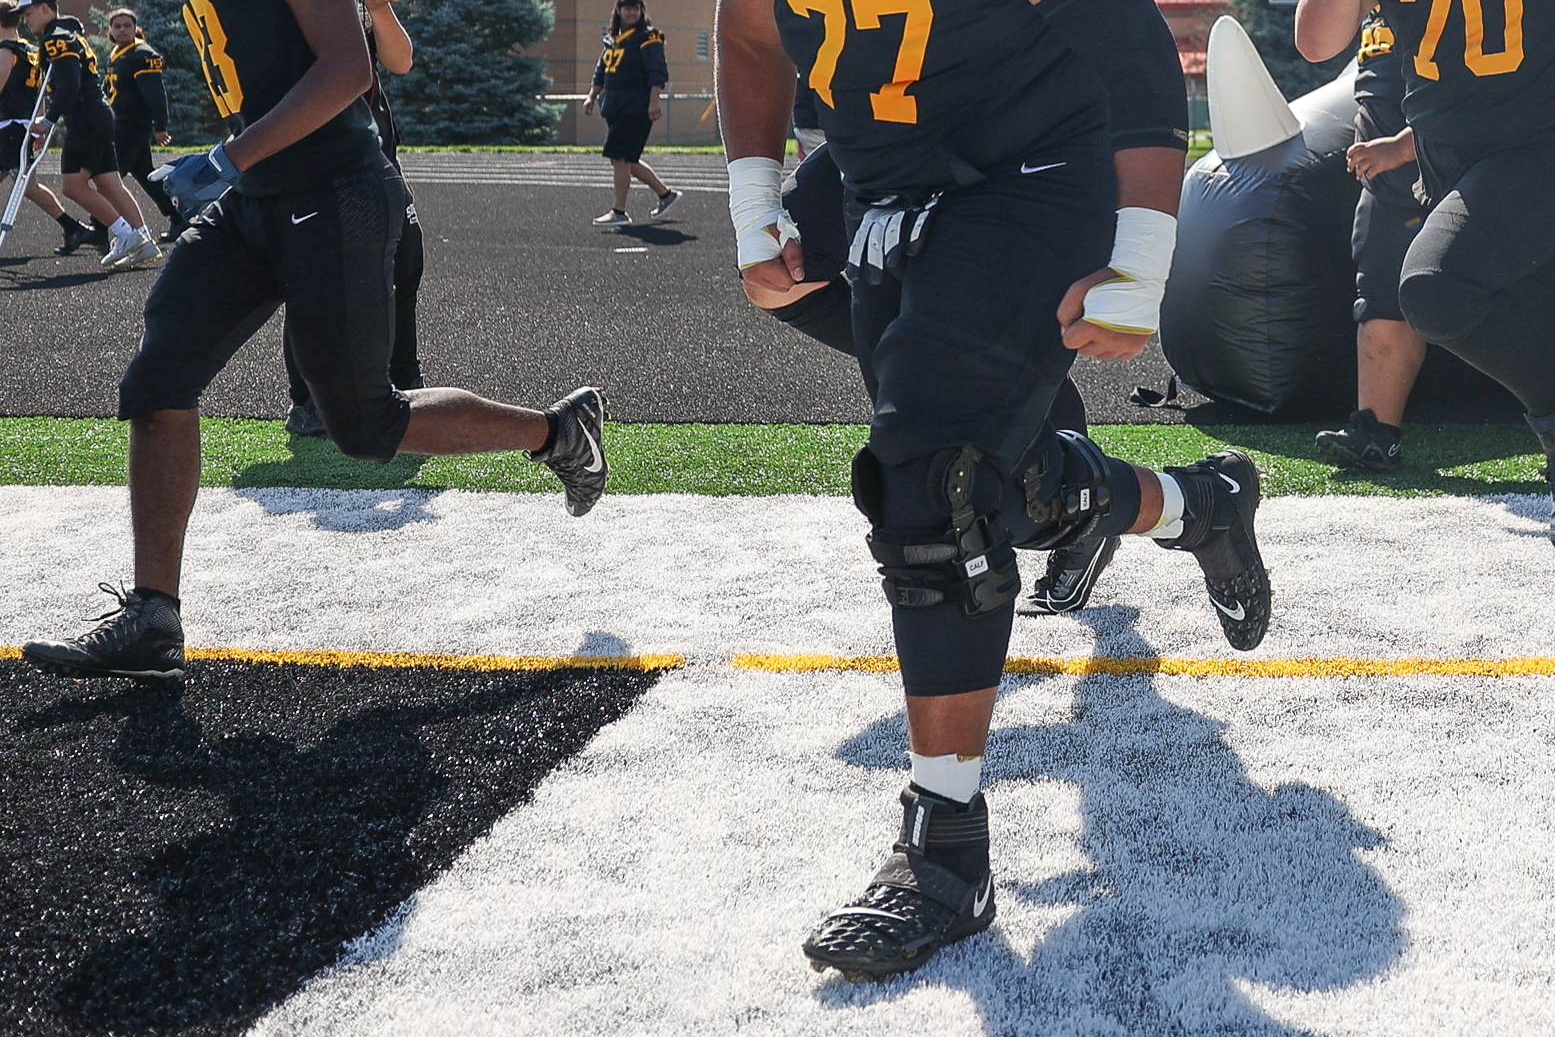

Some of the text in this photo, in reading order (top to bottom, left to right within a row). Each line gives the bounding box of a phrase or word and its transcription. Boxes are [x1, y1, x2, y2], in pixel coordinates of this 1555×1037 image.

[44, 39, 69, 57] 54
[603, 48, 625, 74] 97
[969, 559, 984, 571] CALF
